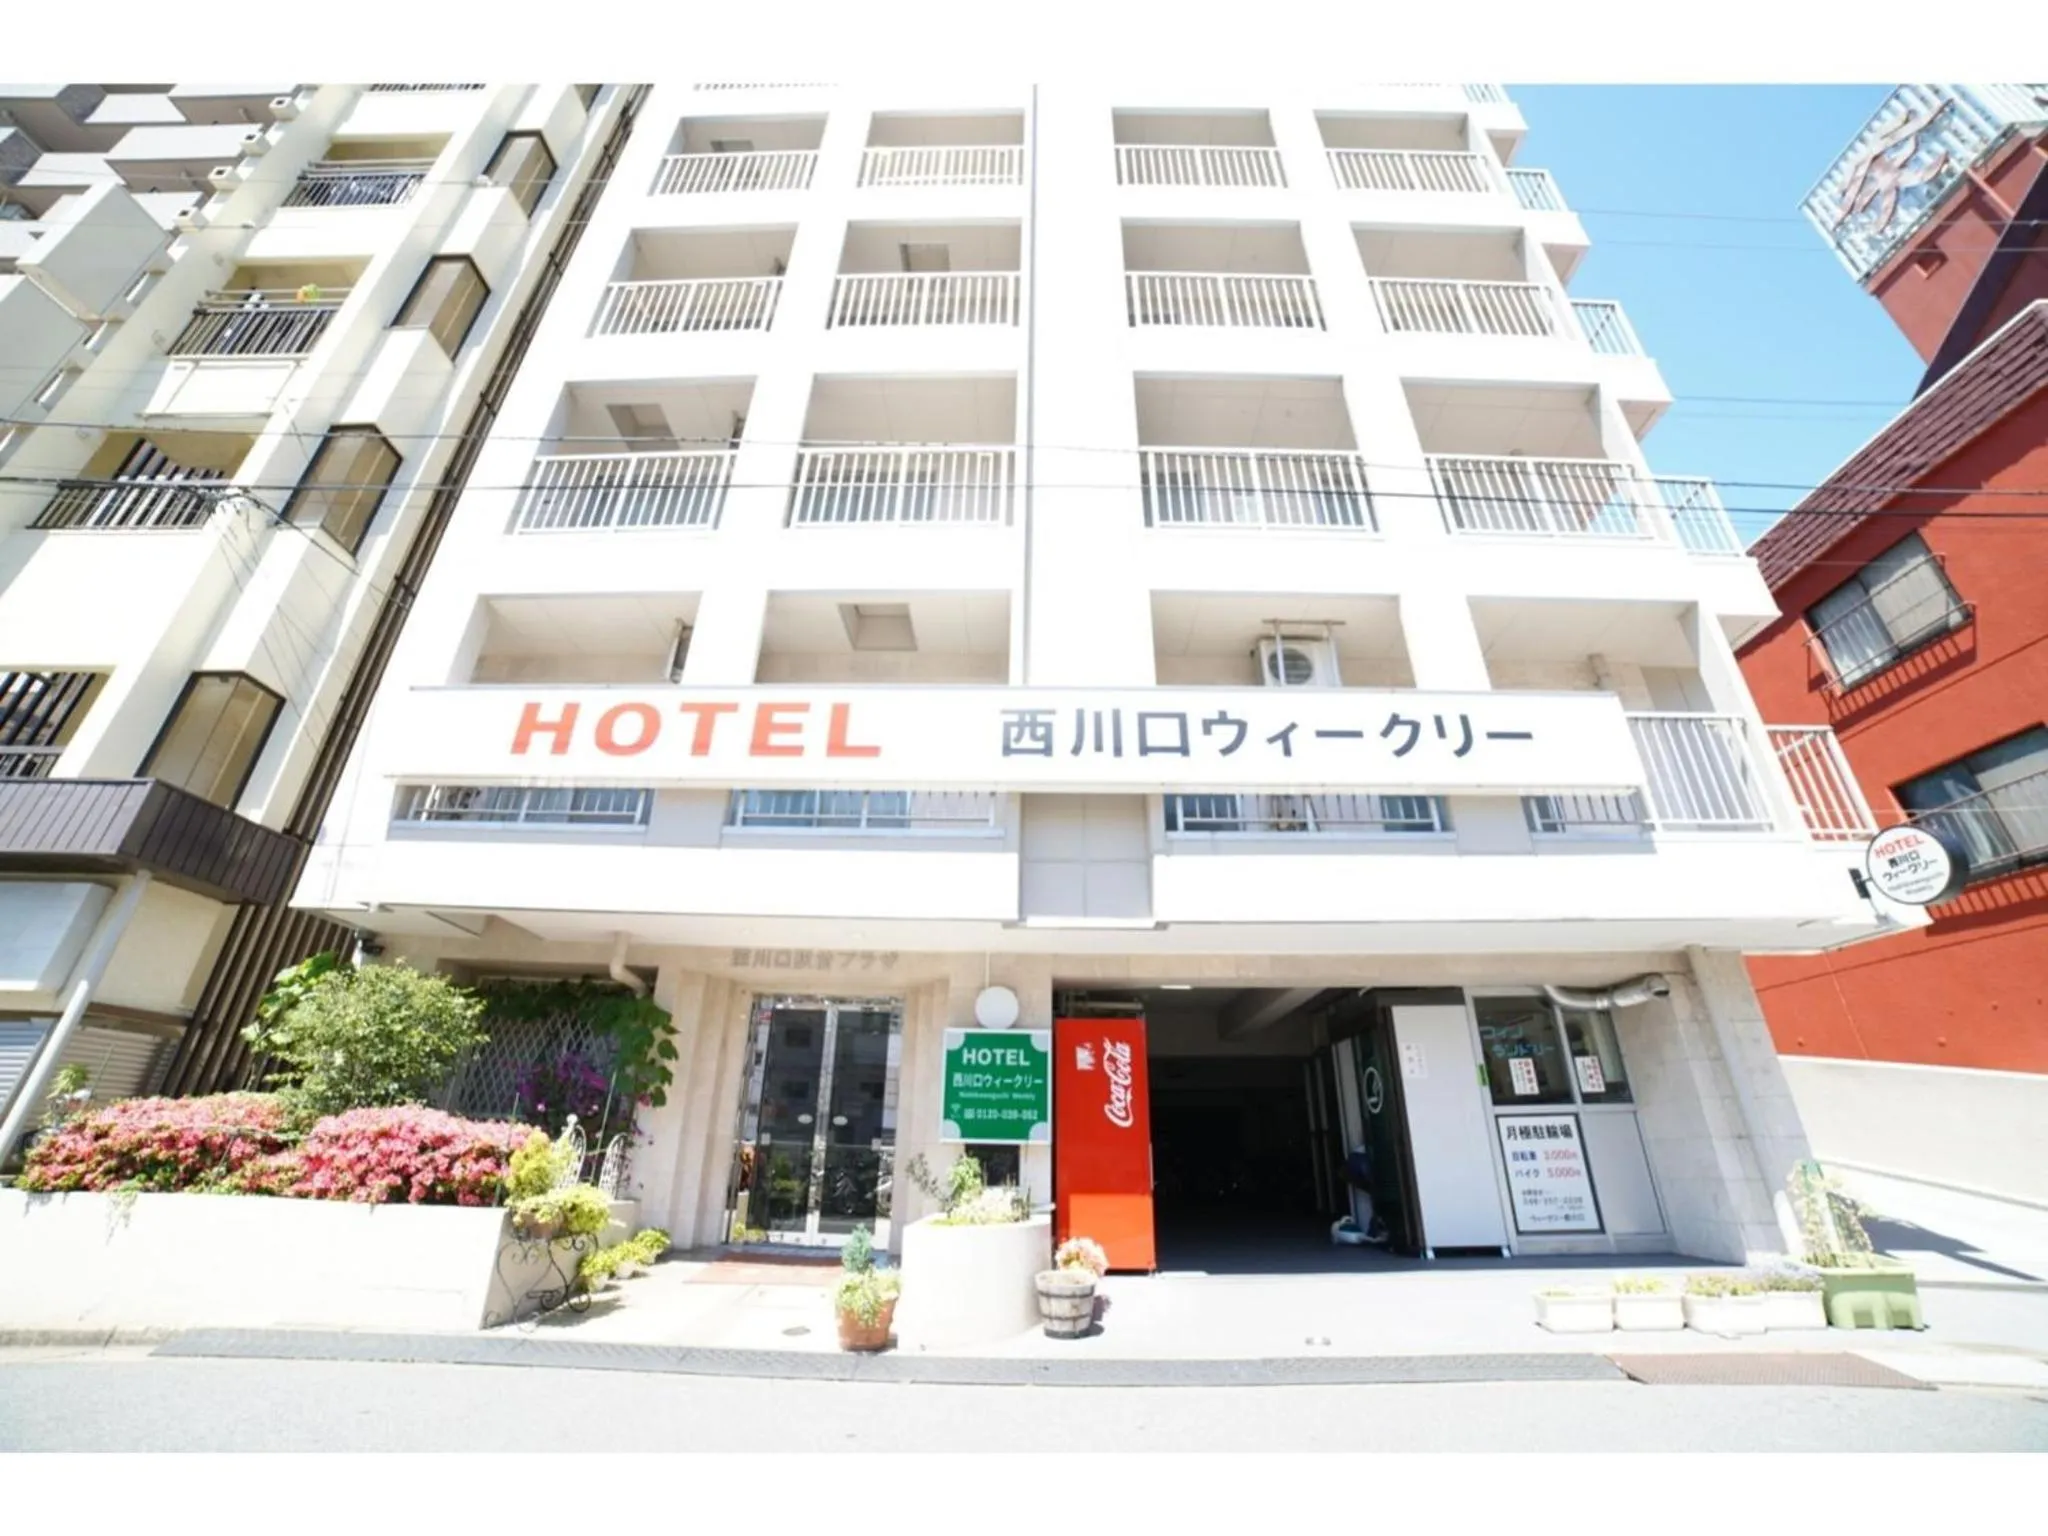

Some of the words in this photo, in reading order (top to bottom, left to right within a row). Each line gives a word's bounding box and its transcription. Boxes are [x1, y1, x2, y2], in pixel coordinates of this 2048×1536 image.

[510, 702, 882, 758] HOTEL
[1000, 707, 1534, 758] 西川口ウィークリー
[1875, 835, 1924, 857] HOTEL
[962, 1048, 1030, 1066] HOTEL
[1506, 1124, 1574, 1140] 月極駐輪場
